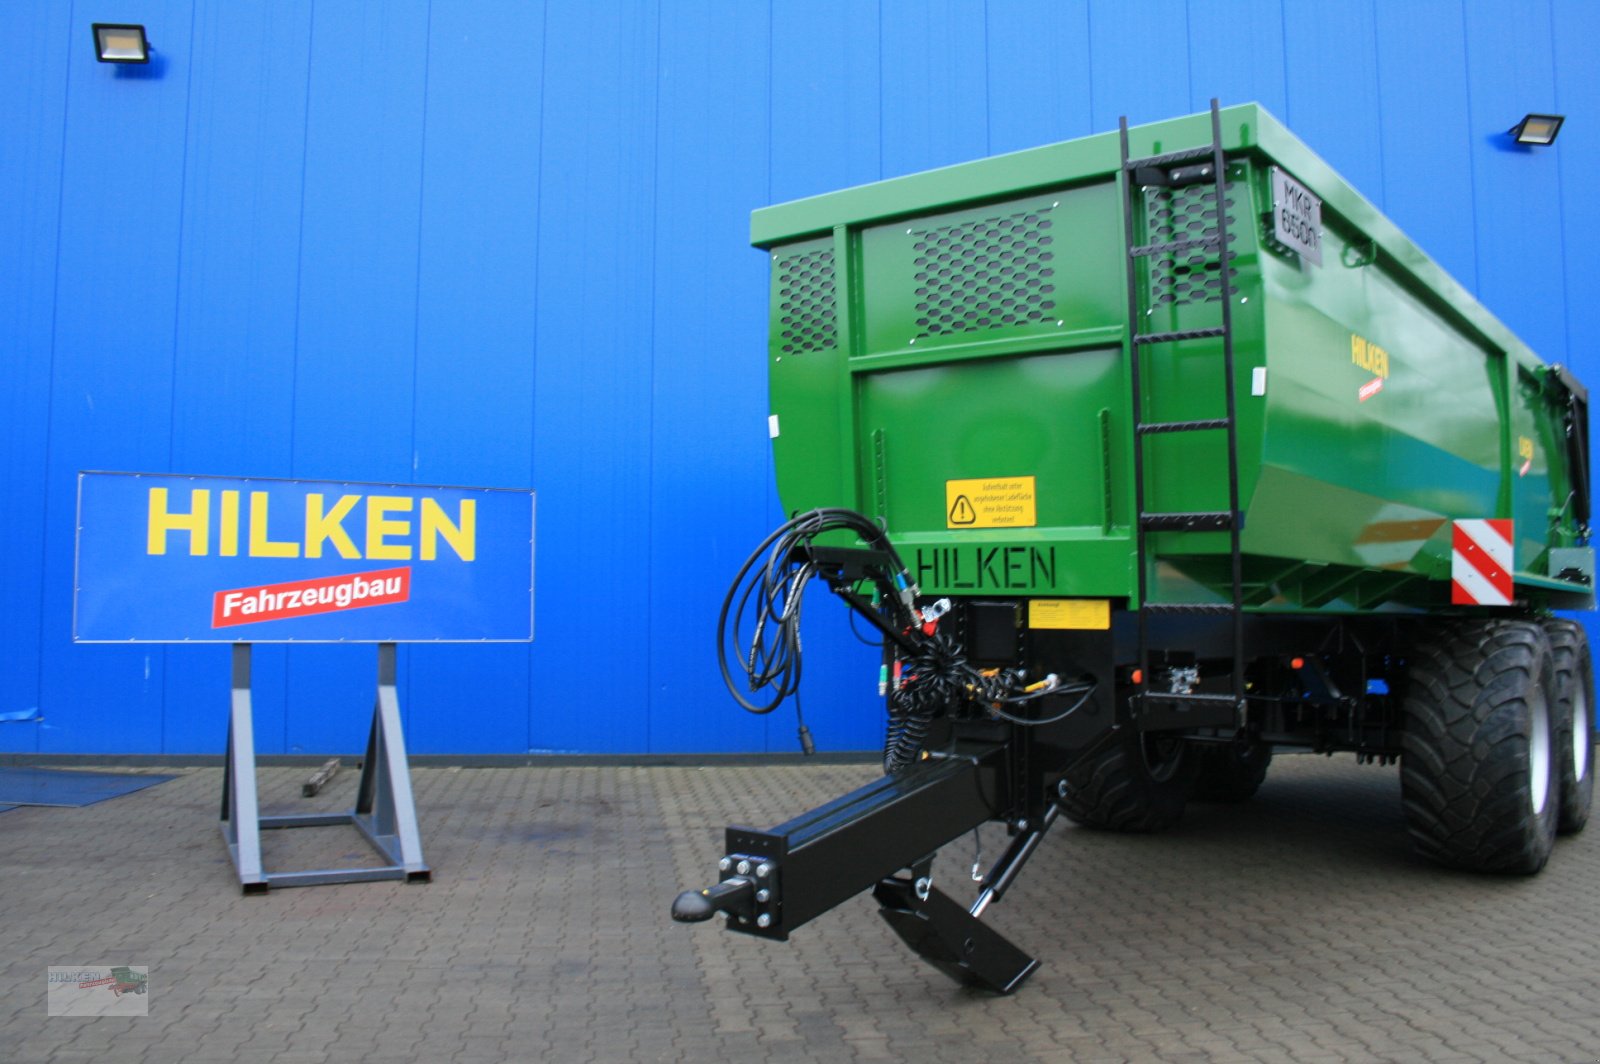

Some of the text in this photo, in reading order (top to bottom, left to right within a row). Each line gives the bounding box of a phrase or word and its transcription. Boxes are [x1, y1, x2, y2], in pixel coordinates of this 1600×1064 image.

[1284, 181, 1311, 221] MKR
[1351, 334, 1389, 380] HILKEN
[147, 487, 476, 561] HILKEN
[917, 547, 1056, 588] HILKEN
[222, 576, 402, 617] Fahrzeugbau
